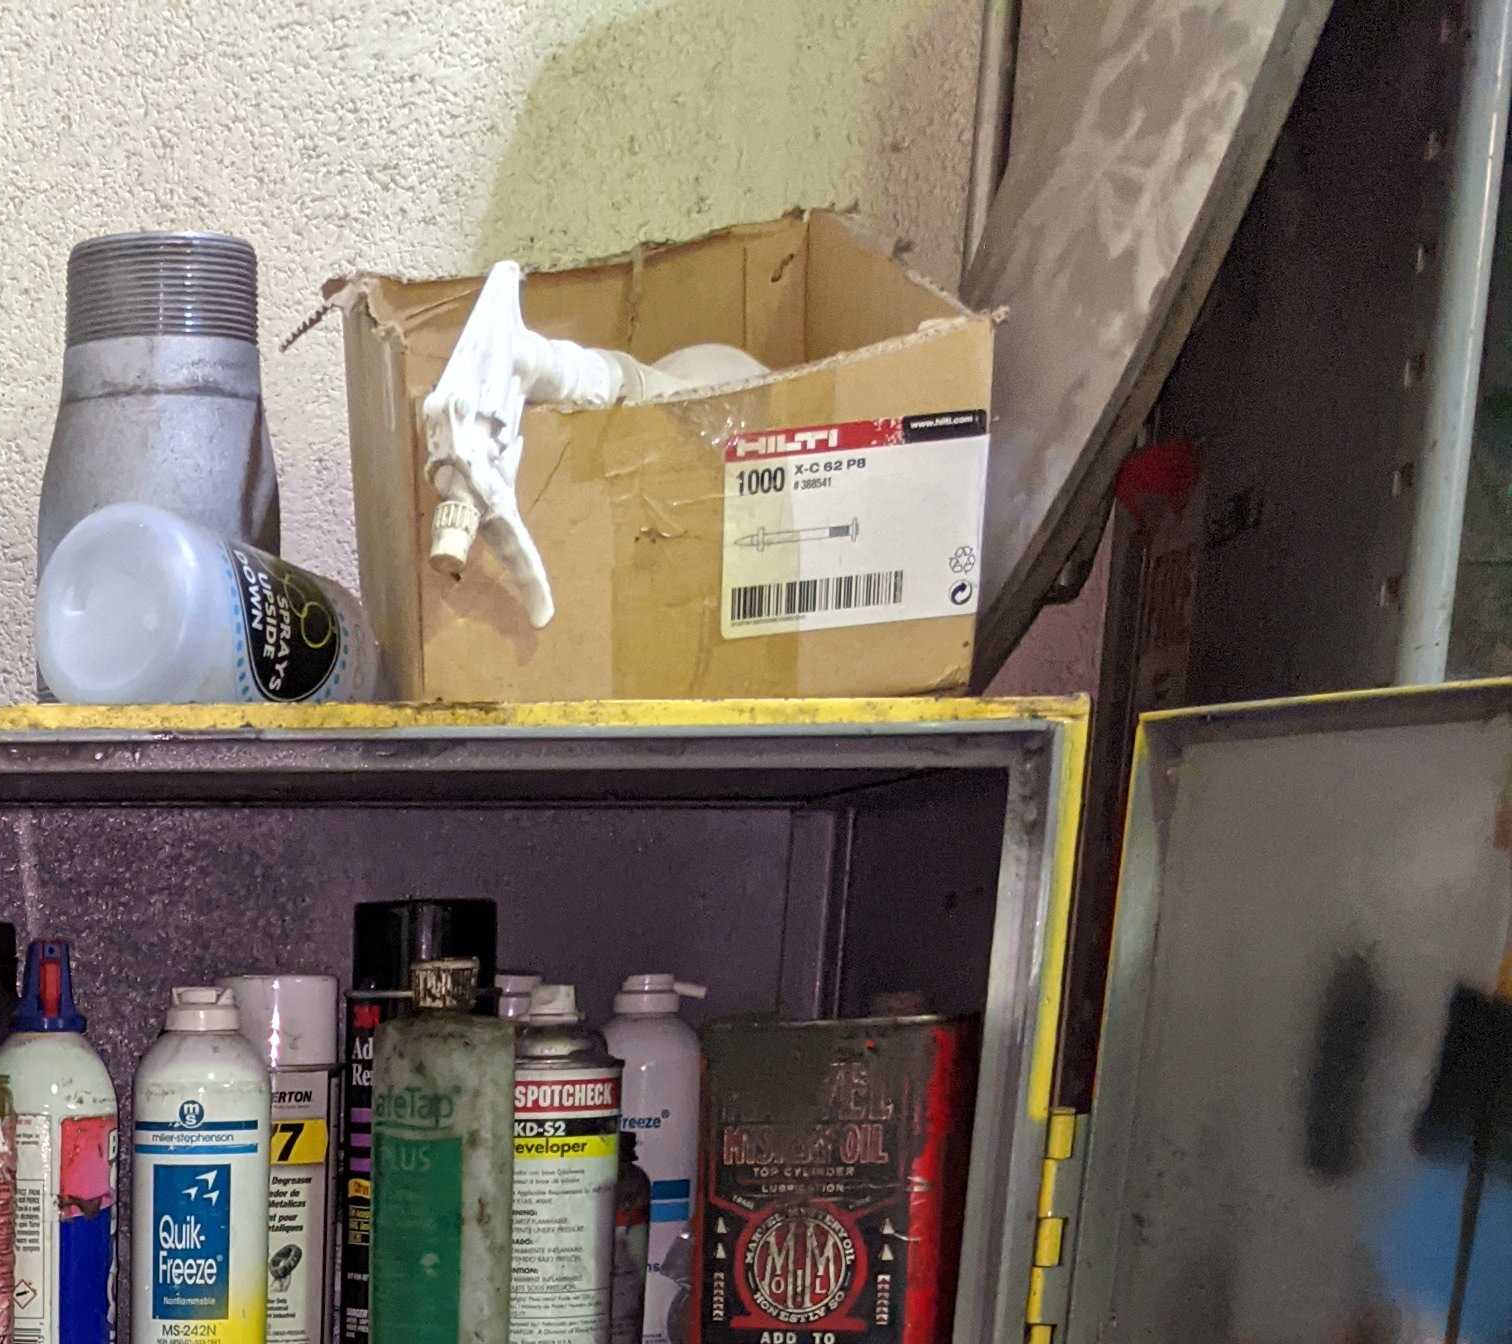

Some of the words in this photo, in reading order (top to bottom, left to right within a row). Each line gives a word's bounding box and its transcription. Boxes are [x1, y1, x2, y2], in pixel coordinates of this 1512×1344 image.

[737, 428, 839, 457] HILTI
[736, 466, 786, 497] 1000
[794, 463, 821, 477] X-C
[823, 461, 843, 473] 62
[846, 457, 867, 471] P8
[233, 549, 263, 632] DOWN
[257, 571, 278, 660] UPSIDE
[268, 594, 292, 692] SPRAYS
[514, 1083, 613, 1108] SPOTCHECK
[152, 1132, 234, 1145] miller-stephenson
[159, 1214, 205, 1250] Quik-
[159, 1250, 217, 1286] Freeze
[163, 1296, 216, 1306] Nonflammable
[753, 1290, 827, 1325] HONESTLY
[830, 1290, 846, 1310] SO
[162, 1324, 217, 1337] MS-242N
